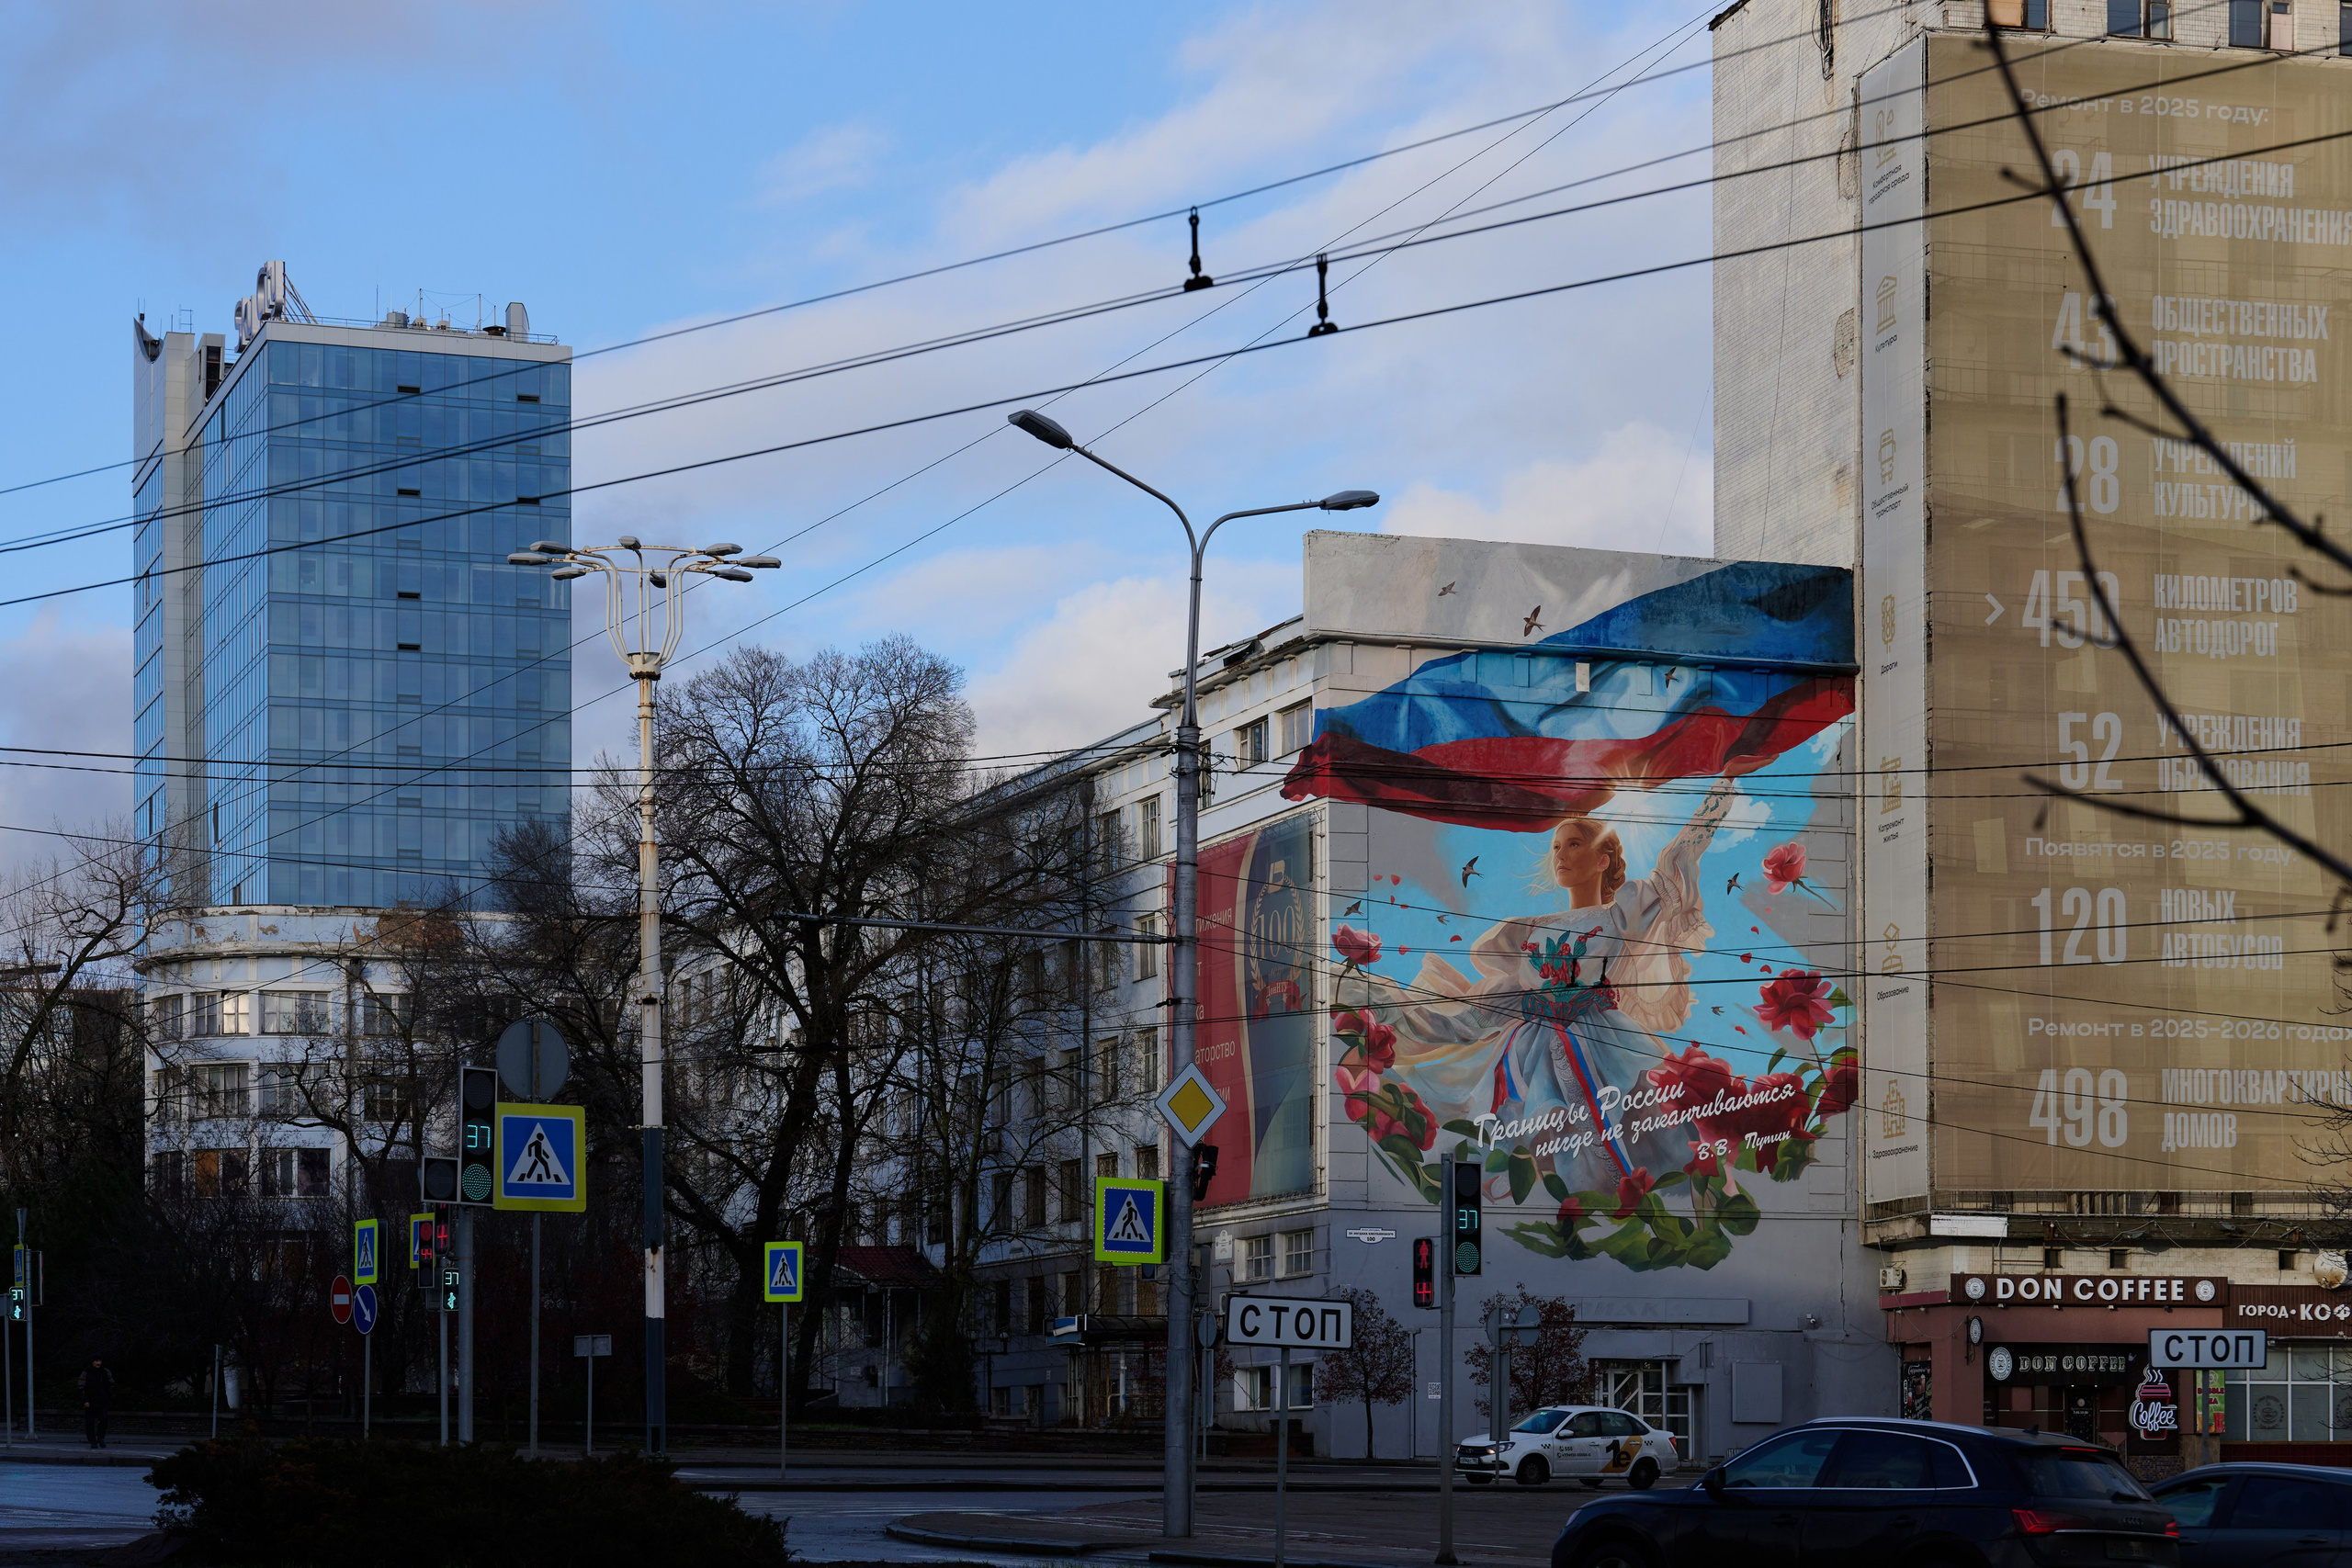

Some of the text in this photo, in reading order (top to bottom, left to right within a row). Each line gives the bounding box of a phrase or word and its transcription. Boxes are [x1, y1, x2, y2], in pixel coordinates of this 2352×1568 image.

[2021, 88, 2269, 127] Ремонт в 2025 году:
[2051, 149, 2117, 230] 24
[2148, 154, 2294, 199] УЧРЕЖДЕНИЯ
[2149, 198, 2352, 245] ЗДРАВООХРАНЕНИЯ
[2052, 292, 2117, 371] 43
[2152, 295, 2329, 340] ОБЩЕСТВЕННЫХ
[1874, 333, 1898, 355] Культура
[2152, 339, 2318, 383] ПРОСТРАНСТВА
[2054, 434, 2120, 514] 28
[1871, 482, 1909, 511] Общественный
[1875, 500, 1902, 520] транспорт
[2154, 481, 2269, 522] КУЛЬТУРЫ
[2022, 570, 2120, 649] 450
[2154, 573, 2298, 614] КИЛОМЕТРОВ
[2154, 617, 2279, 660] АВТОДОРОГ
[1881, 660, 1898, 676] Дороги
[2057, 712, 2123, 790] 52
[2156, 713, 2301, 755] УЧРЕЖДЕНИЯ
[1878, 818, 1905, 834] Капремонт
[1883, 831, 1899, 844] жилья
[2026, 837, 2146, 858] Появятся
[2153, 843, 2166, 859] в
[2170, 840, 2231, 861] 2025
[2160, 888, 2237, 925] НОВЫХ
[1259, 905, 1295, 961] 100
[2030, 887, 2127, 966] 120
[2160, 933, 2284, 971] АВТОБУСОВ
[1876, 985, 1910, 1001] Образование
[2028, 1018, 2124, 1037] Ремонт
[2131, 1022, 2144, 1037] в
[2150, 1019, 2280, 1041] 2025-2026
[1472, 1080, 1687, 1152] Границы России
[1535, 1083, 1796, 1157] нигде не заканчиваются
[2029, 1067, 2128, 1148] 498
[467, 1124, 491, 1149] 37
[1745, 1129, 1792, 1152] Путин
[2161, 1112, 2237, 1153] ДОМОВ
[1871, 1145, 1919, 1160] Здравоохранение
[1458, 1209, 1477, 1229] 37
[421, 1247, 433, 1260] 44
[11, 1289, 24, 1301] 37
[445, 1271, 459, 1285] 37
[1996, 1278, 2063, 1301] DON
[2073, 1279, 2185, 1302] COFFEE
[1239, 1304, 1341, 1342] СТОП
[2238, 1304, 2289, 1319] ГОРОД
[2018, 1356, 2058, 1372] DON
[2062, 1355, 2126, 1372] COFFEE
[2164, 1335, 2254, 1363] СТОП
[2132, 1402, 2176, 1432] Coffee
